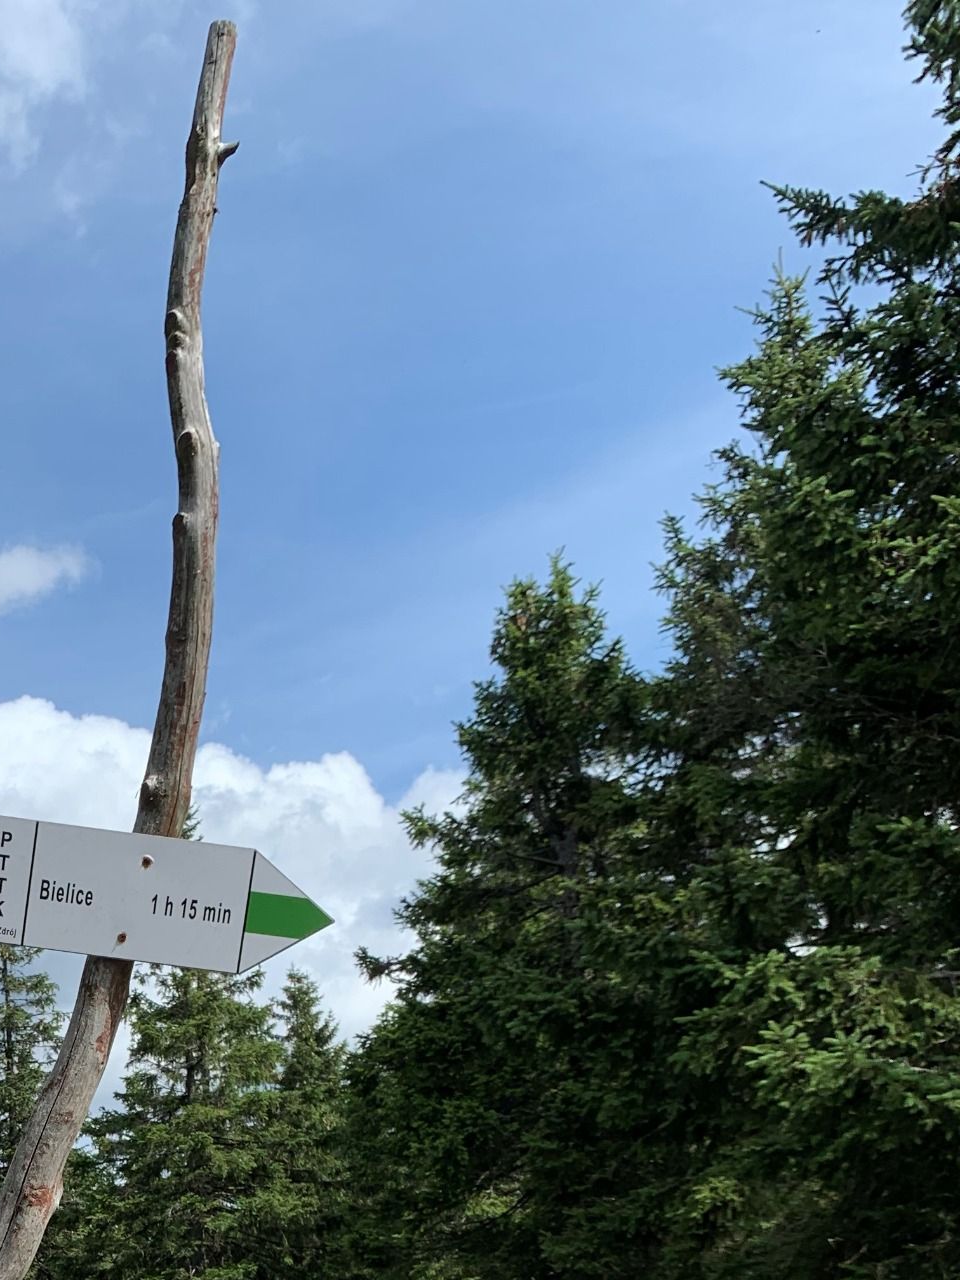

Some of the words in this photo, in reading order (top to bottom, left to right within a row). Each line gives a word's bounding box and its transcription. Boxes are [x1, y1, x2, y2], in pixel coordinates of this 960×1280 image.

[39, 879, 94, 907] Bielice
[151, 893, 158, 915] 1
[164, 895, 174, 917] h
[181, 898, 198, 920] 15
[202, 902, 232, 924] min
